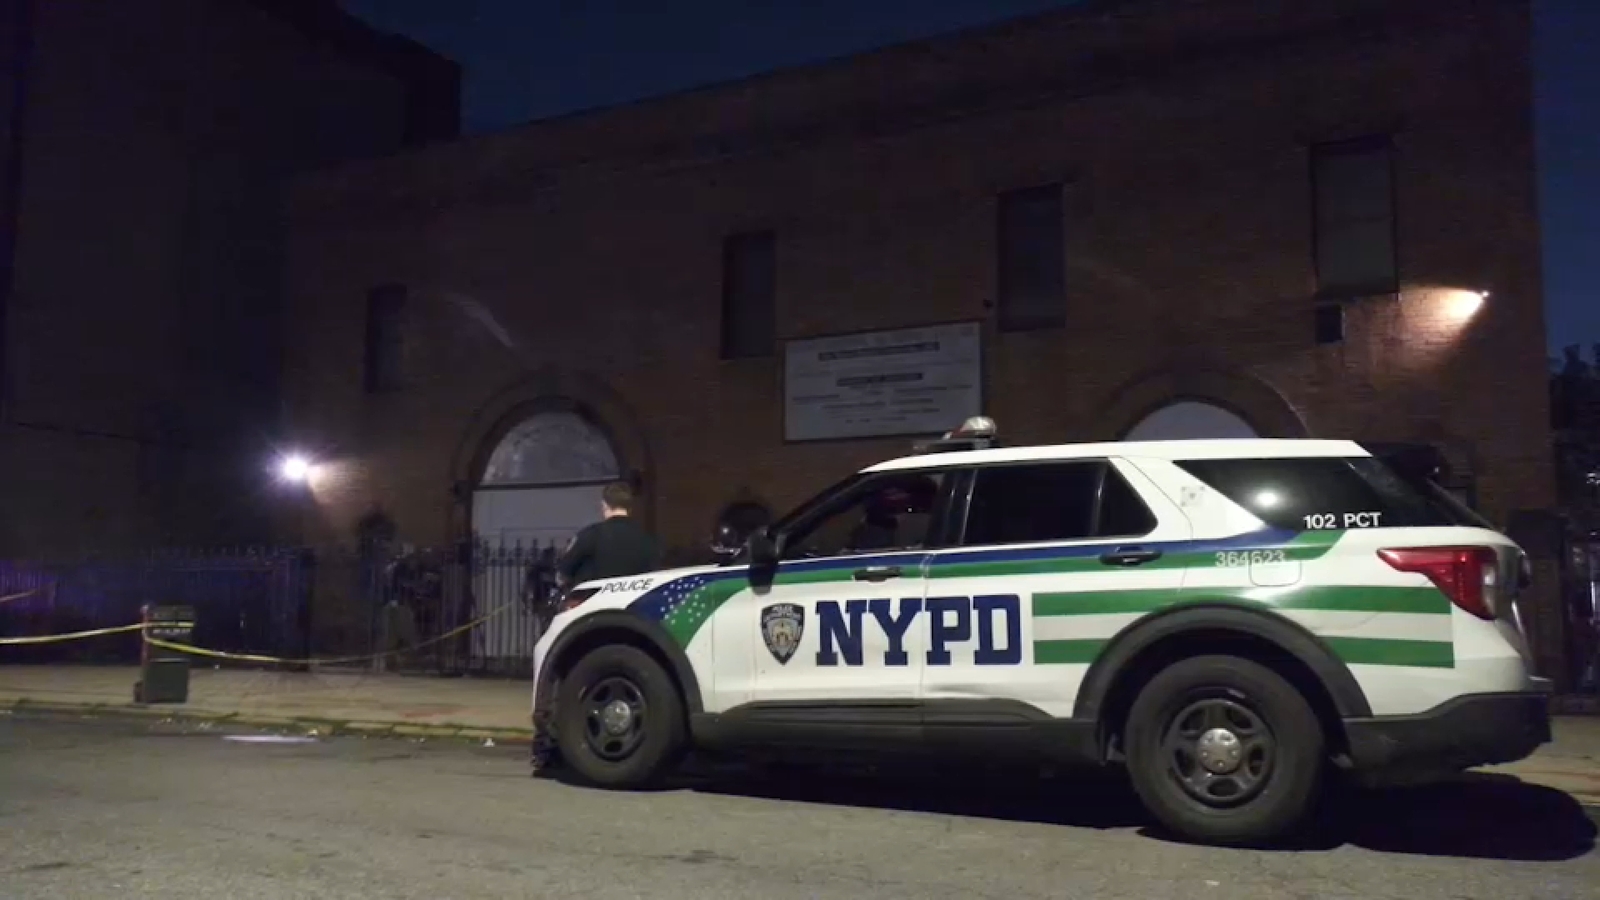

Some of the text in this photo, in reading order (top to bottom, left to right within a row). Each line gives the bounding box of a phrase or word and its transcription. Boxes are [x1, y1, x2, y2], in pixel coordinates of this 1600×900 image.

[1303, 512, 1382, 529] 102 PCT
[1214, 549, 1285, 568] 364623
[601, 577, 654, 594] POLICE
[815, 594, 1022, 667] NYPD
